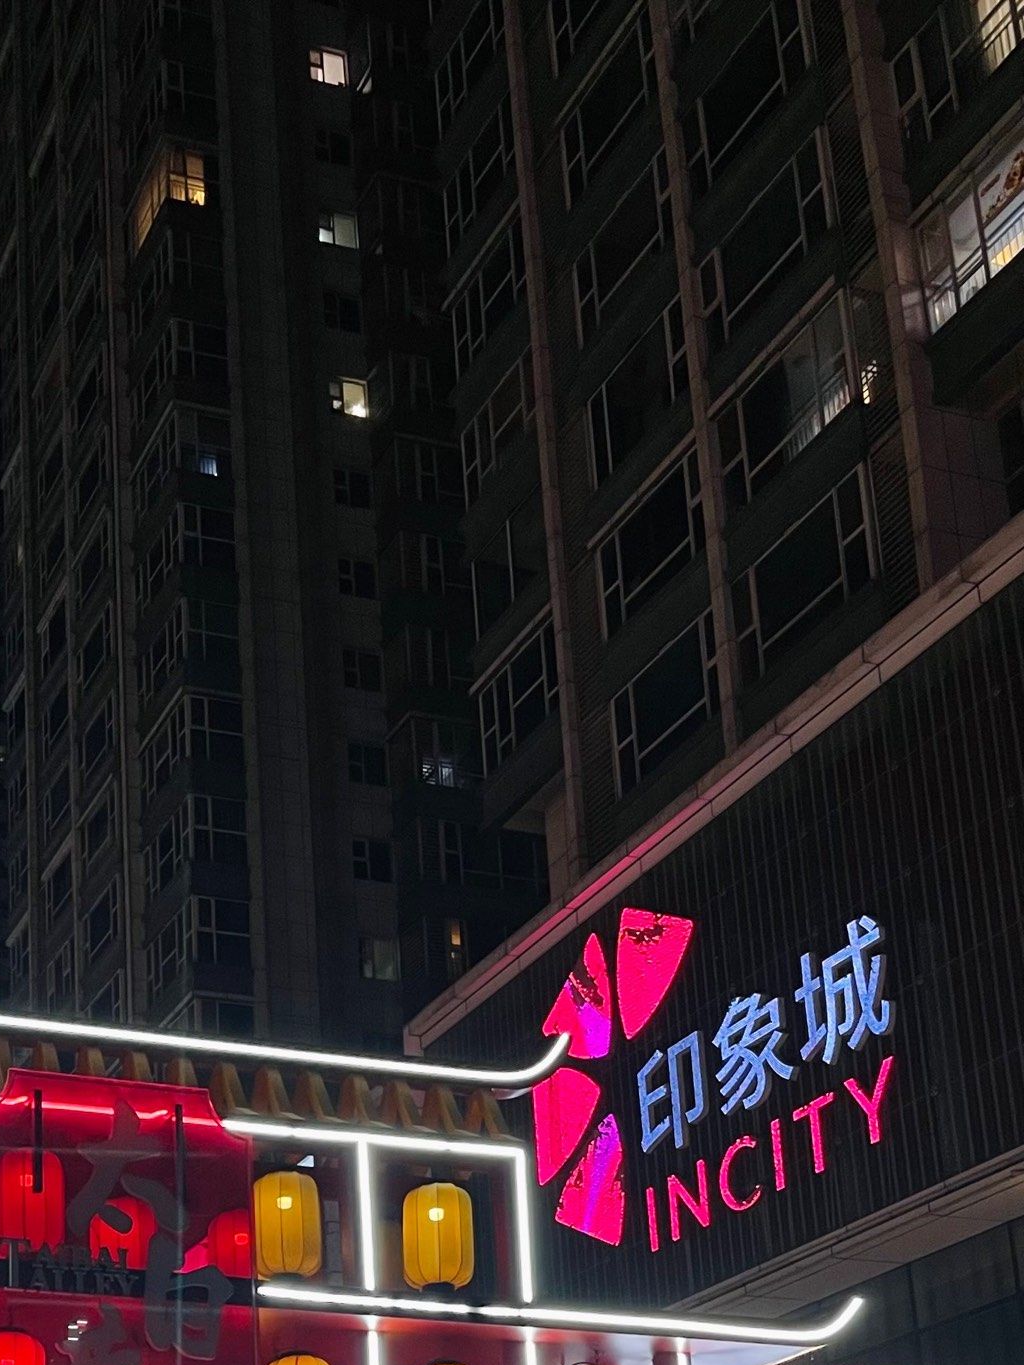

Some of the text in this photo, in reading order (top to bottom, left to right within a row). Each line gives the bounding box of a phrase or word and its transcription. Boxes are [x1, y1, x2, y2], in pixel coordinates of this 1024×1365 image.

[636, 914, 894, 1154] 印象城
[645, 1055, 895, 1253] INCITY
